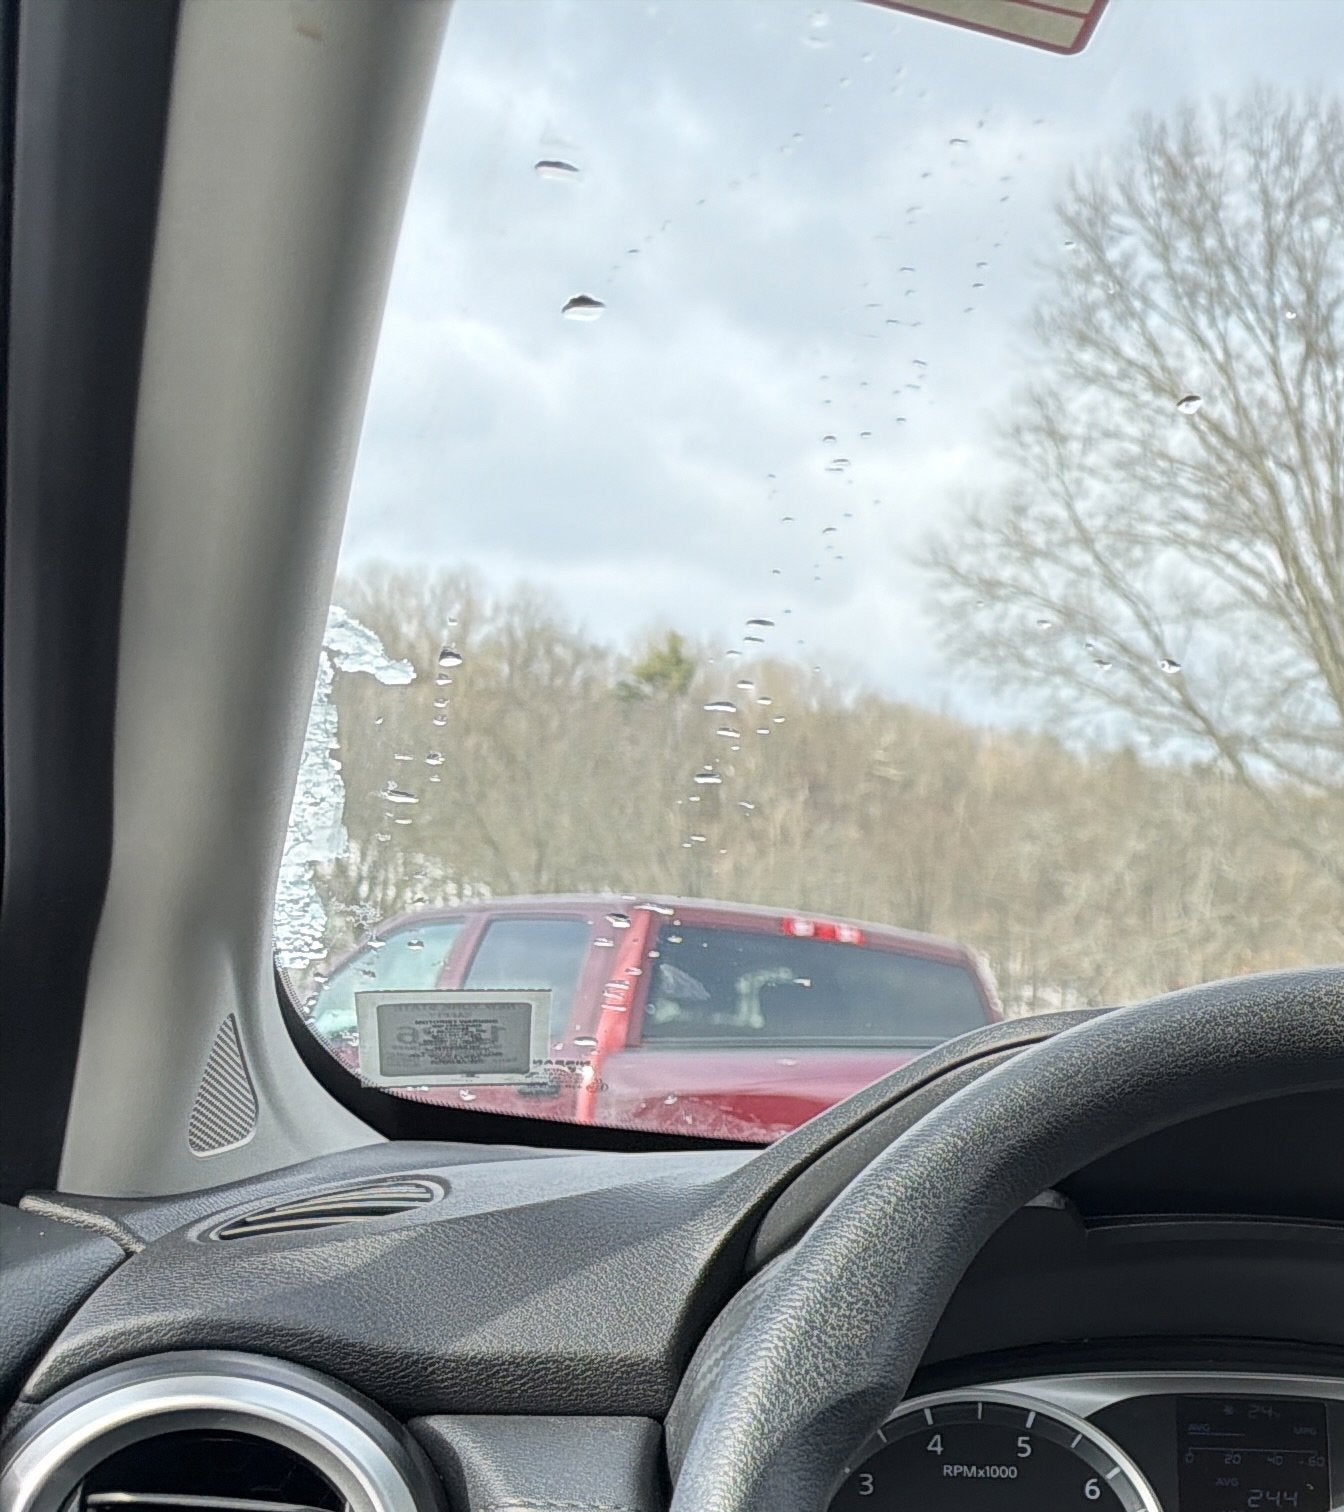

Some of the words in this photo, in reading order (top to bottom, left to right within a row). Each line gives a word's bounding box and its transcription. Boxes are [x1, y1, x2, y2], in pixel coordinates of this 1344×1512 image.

[926, 1434, 944, 1456] 4
[1016, 1437, 1033, 1458] 5
[1224, 1453, 1241, 1465] 20
[942, 1464, 1018, 1479] RPMx1000
[1215, 1477, 1239, 1487] AVG
[859, 1473, 875, 1495] 3
[1084, 1478, 1101, 1500] 6
